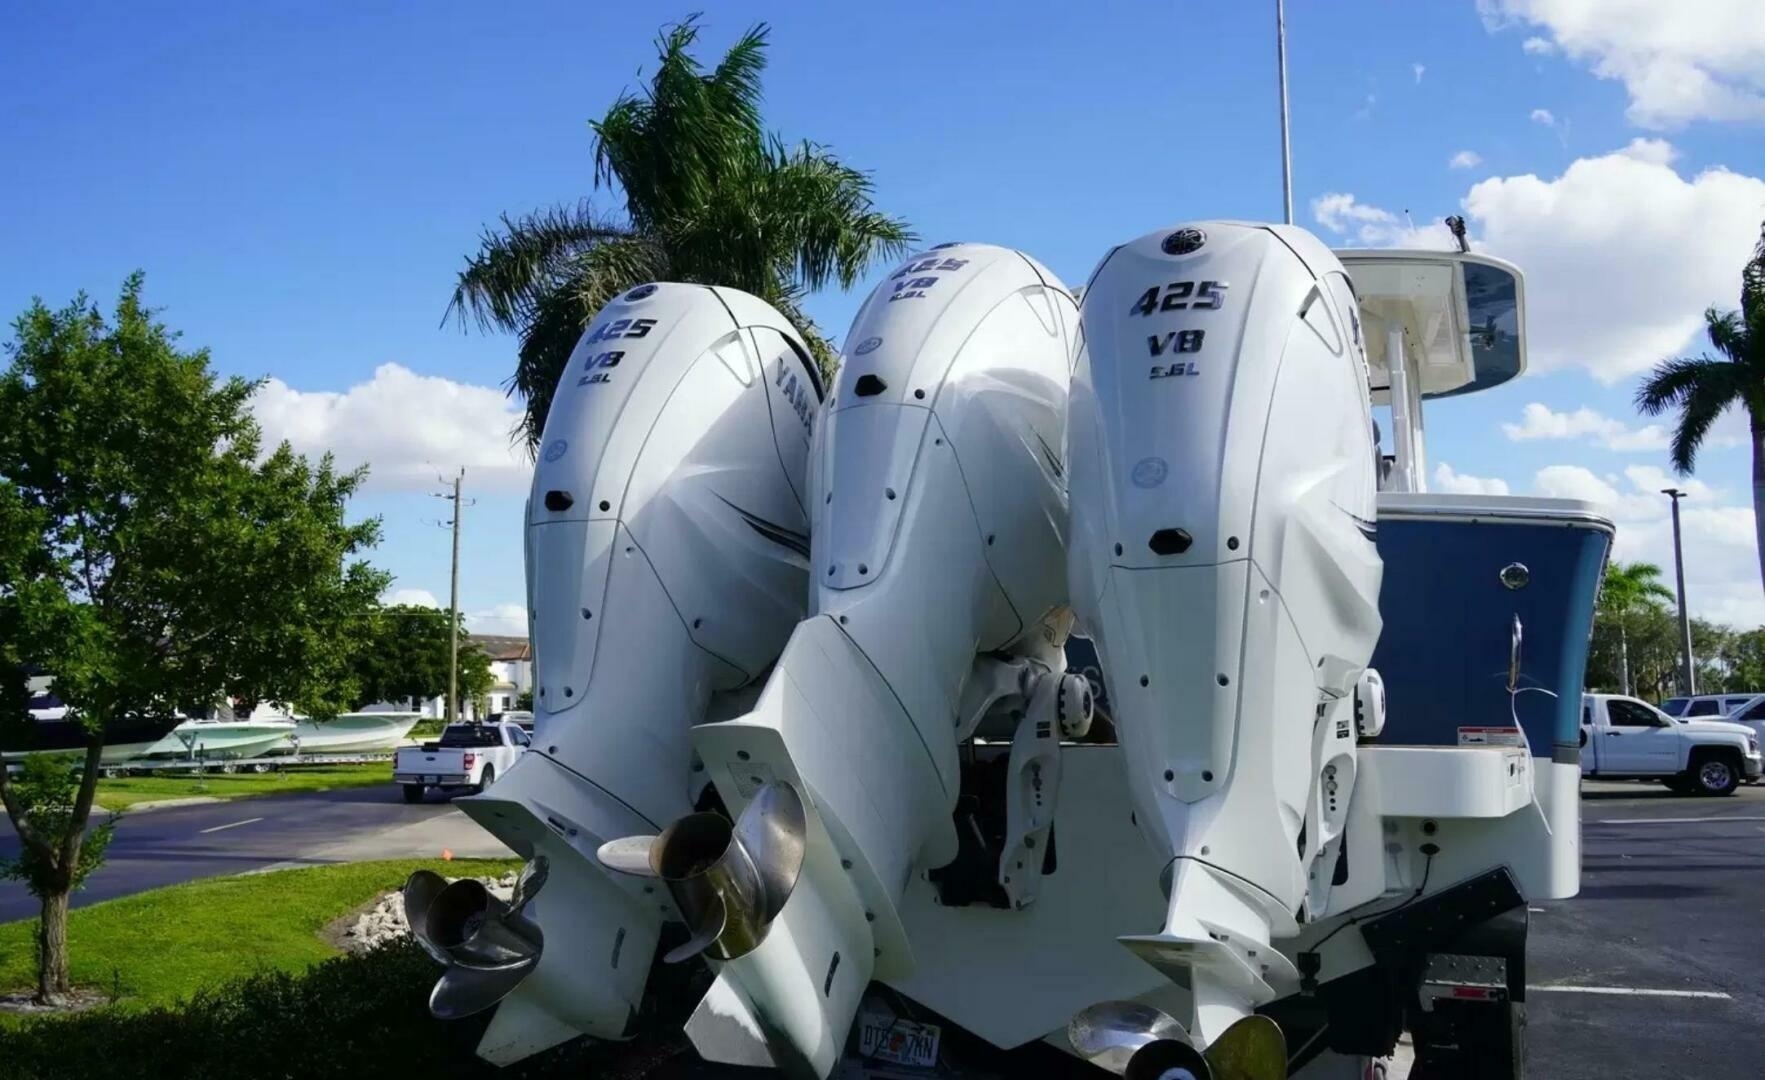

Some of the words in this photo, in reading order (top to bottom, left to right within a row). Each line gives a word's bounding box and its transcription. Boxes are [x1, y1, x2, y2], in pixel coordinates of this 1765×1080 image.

[890, 258, 970, 280] 425
[894, 277, 939, 292] V8
[1129, 281, 1228, 317] 425
[586, 319, 658, 345] 425
[1147, 329, 1206, 357] V8
[584, 351, 625, 371] V8
